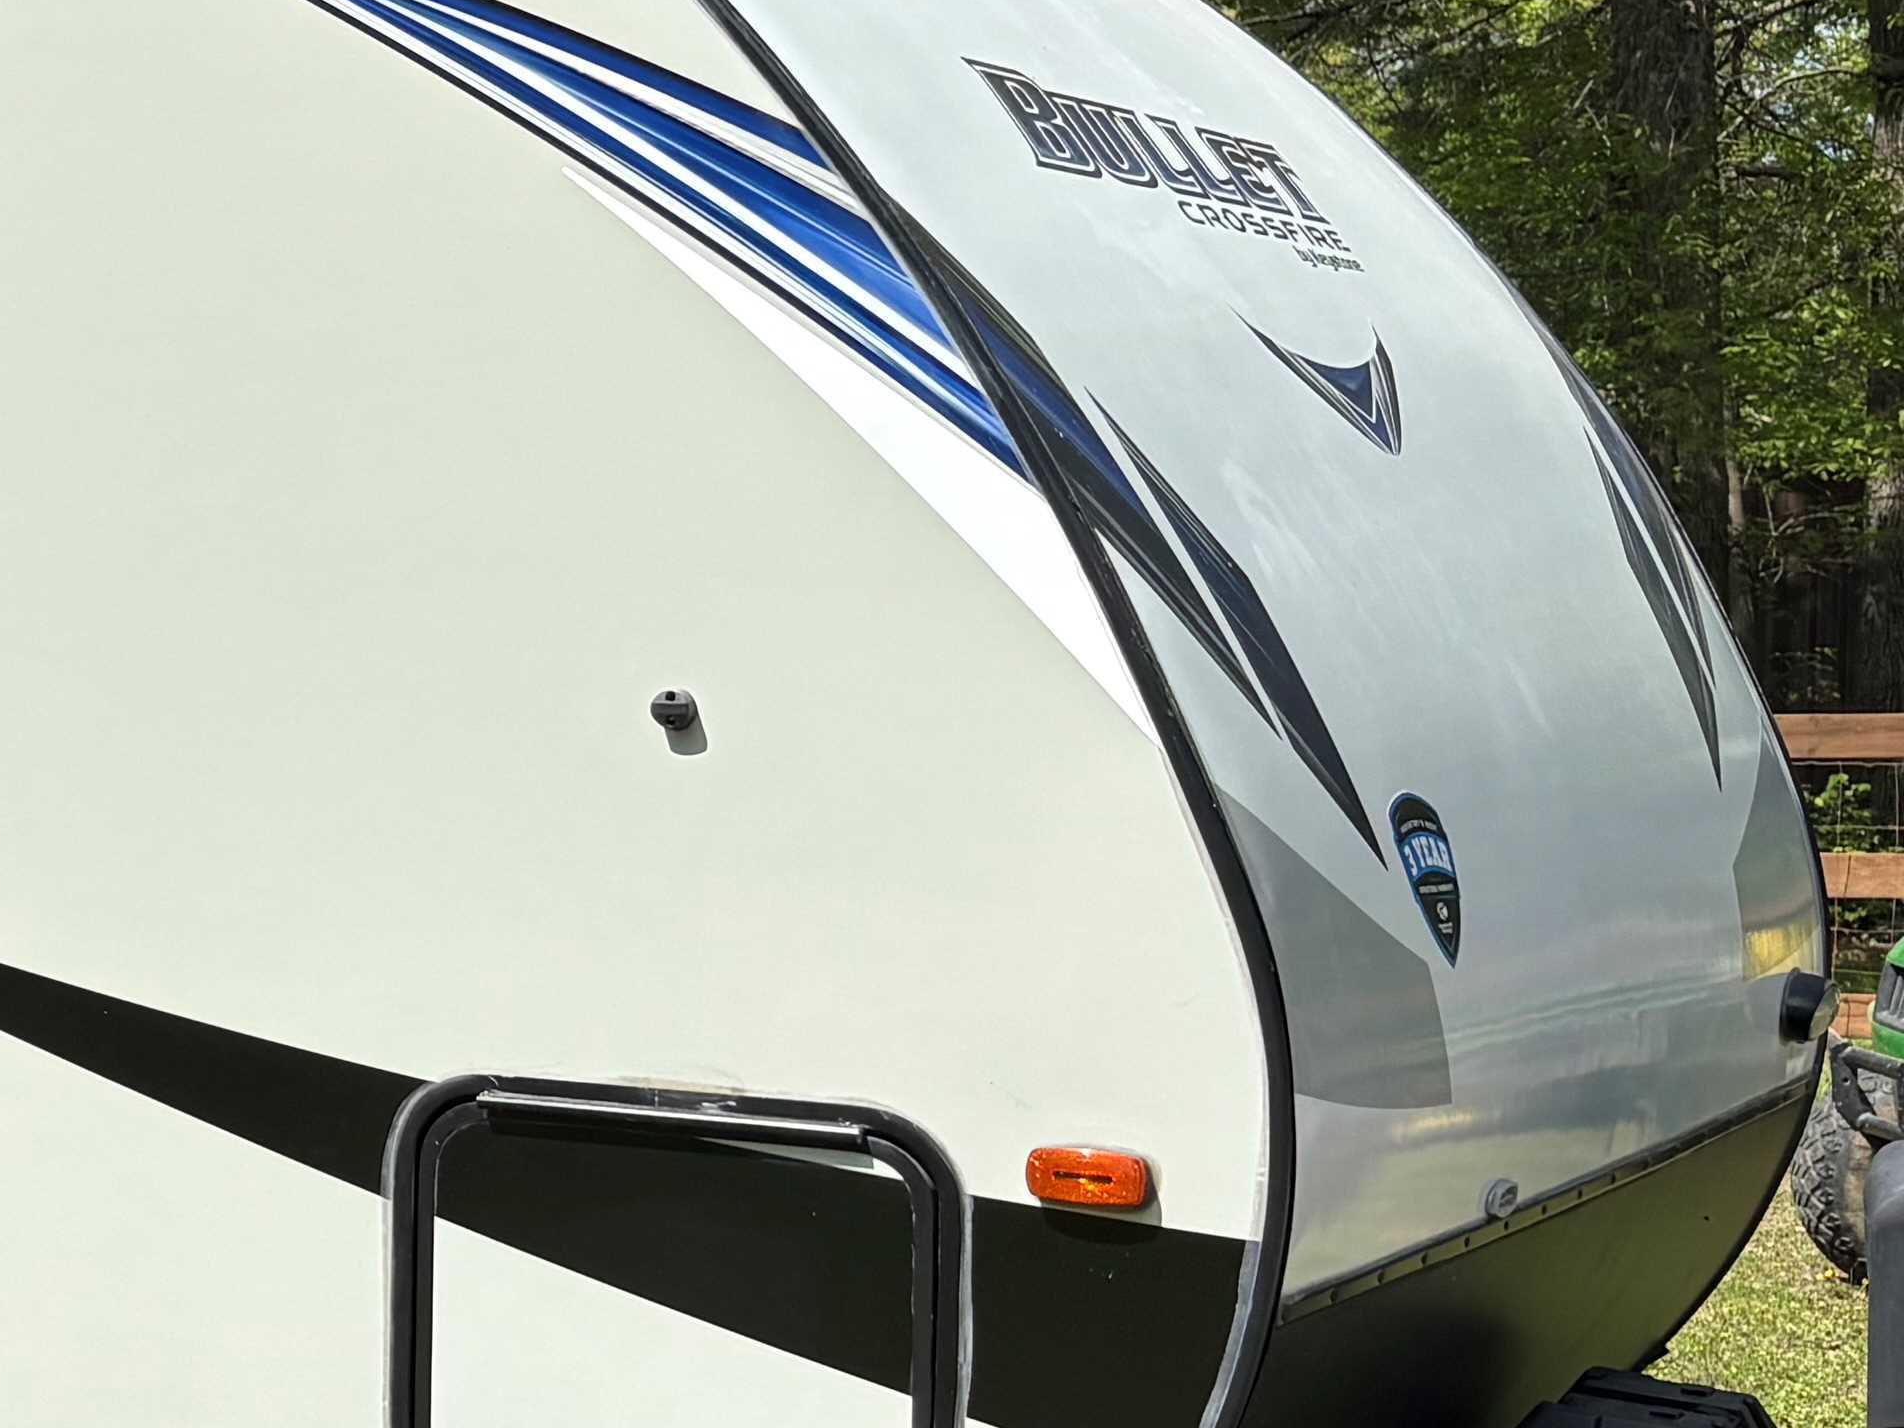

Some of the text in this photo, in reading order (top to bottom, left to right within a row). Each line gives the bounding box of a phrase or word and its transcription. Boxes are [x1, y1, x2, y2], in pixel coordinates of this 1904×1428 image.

[960, 56, 1331, 224] BULLET
[1178, 199, 1352, 252] CROSSFIRE
[1403, 835, 1453, 877] 3 YEAR
